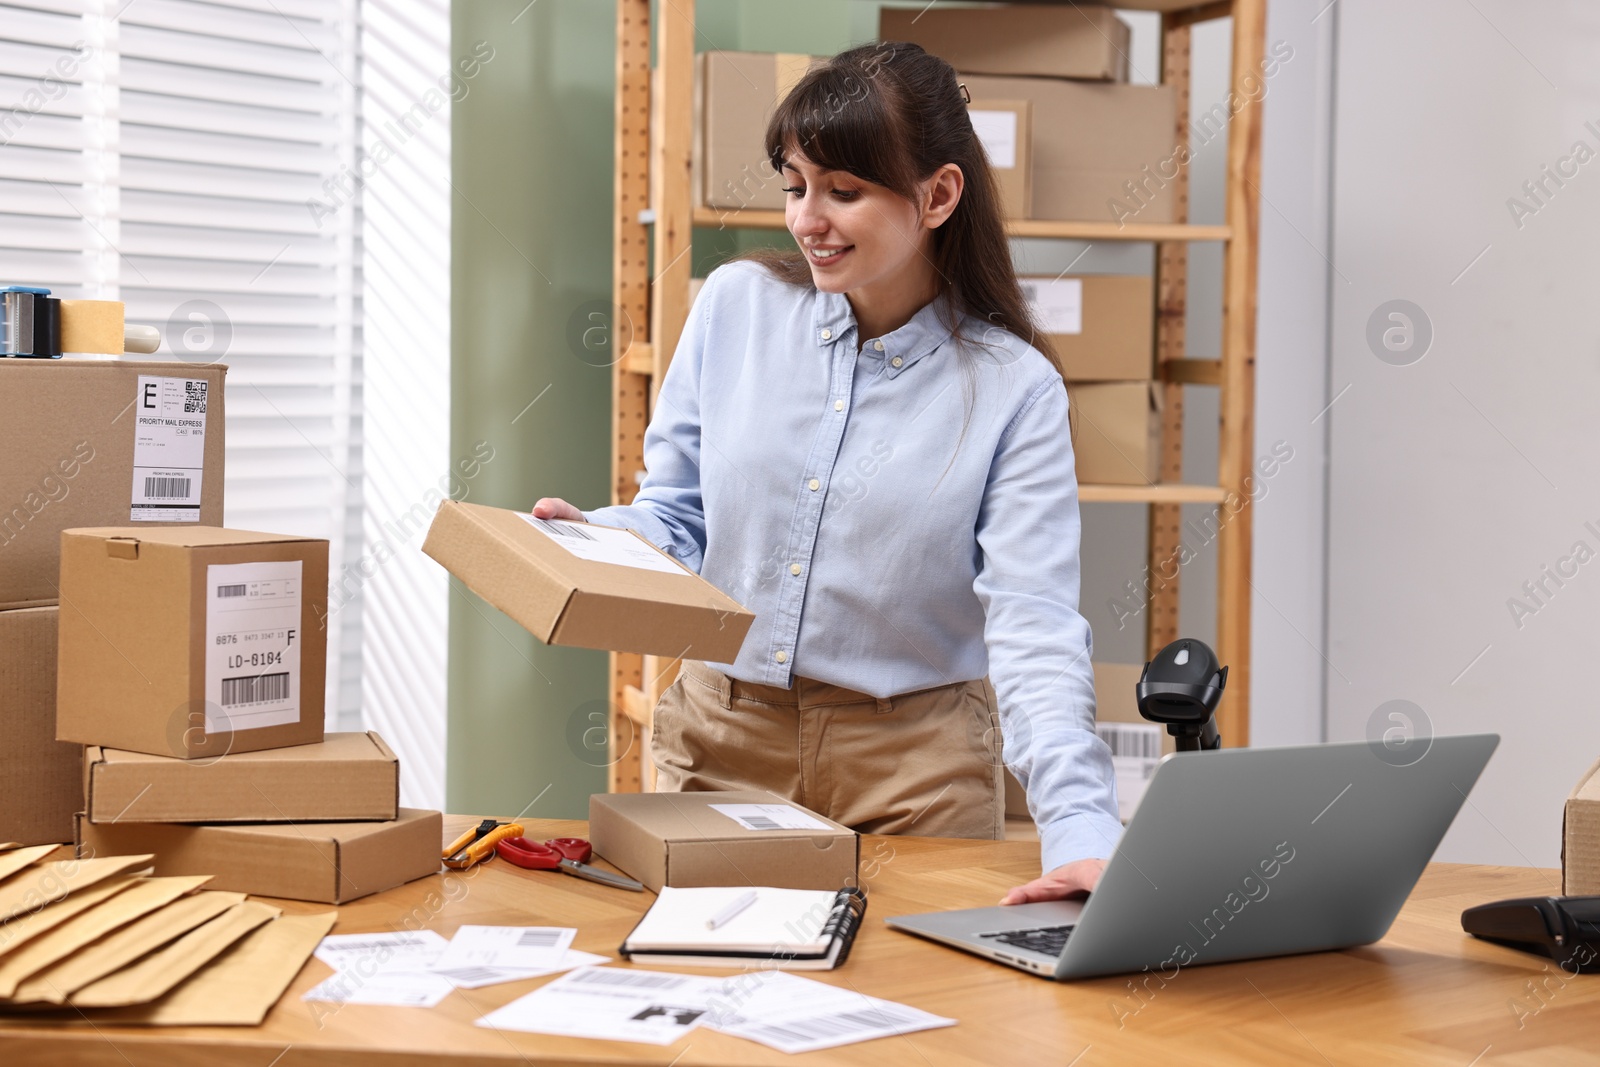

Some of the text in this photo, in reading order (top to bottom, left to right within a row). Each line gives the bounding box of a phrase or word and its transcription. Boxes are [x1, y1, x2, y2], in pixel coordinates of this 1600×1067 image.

[143, 383, 157, 409] E
[139, 417, 203, 428] PRIORITY MAIL EXPRESS
[287, 630, 296, 646] F
[228, 651, 282, 669] LD-0104
